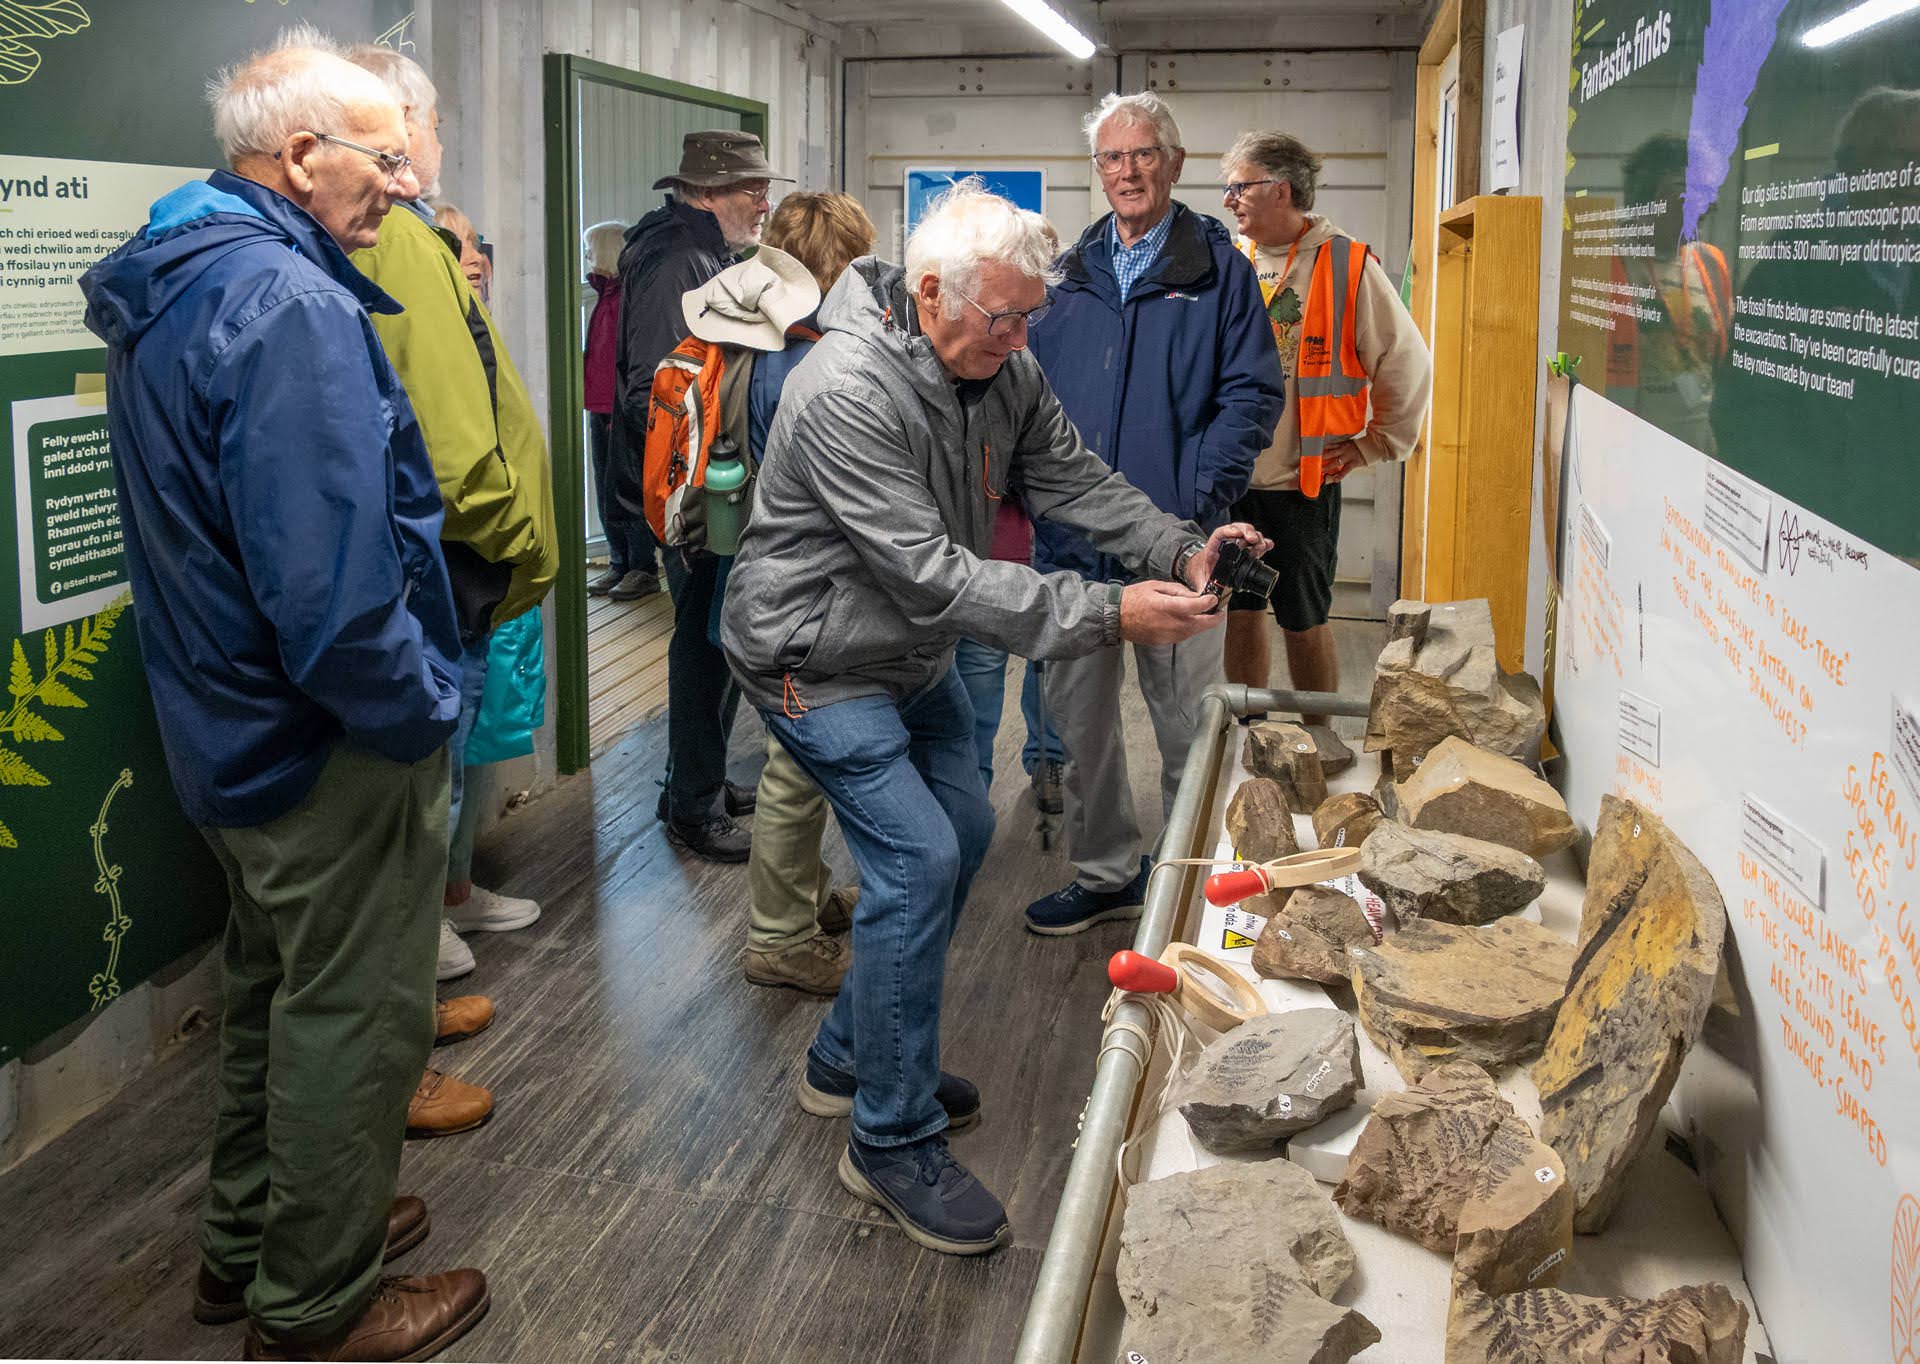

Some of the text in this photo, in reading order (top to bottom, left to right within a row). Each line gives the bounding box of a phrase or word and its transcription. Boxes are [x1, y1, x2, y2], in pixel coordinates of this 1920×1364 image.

[1581, 31, 1632, 104] Fantastic
[1634, 10, 1671, 71] finds
[55, 176, 88, 199] ati
[1742, 186, 1754, 205] Our
[1754, 185, 1765, 207] dig
[1766, 183, 1779, 202] site
[1780, 181, 1787, 201] is
[1787, 176, 1826, 201] brimming
[1827, 172, 1849, 195] with
[1849, 169, 1898, 192] evidence
[1899, 161, 1914, 187] of
[1740, 214, 1758, 232] From
[1758, 213, 1794, 230] enormous
[1795, 209, 1825, 229] insects
[1825, 208, 1835, 228] to
[1836, 201, 1899, 231] microscopic
[16, 227, 34, 239] chi
[37, 228, 72, 239] erioed
[74, 229, 99, 240] wedi
[4, 243, 31, 255] wedi
[34, 243, 73, 255] chwilio
[75, 245, 92, 254] am
[1739, 244, 1756, 259] more
[1756, 241, 1777, 259] about
[1777, 240, 1792, 260] this
[1792, 241, 1809, 260] 300
[1810, 240, 1838, 261] million
[1840, 244, 1862, 266] year
[1863, 239, 1881, 262] old
[7, 259, 50, 270] ffosilau
[53, 261, 66, 272] yn
[6, 275, 46, 288] cynnig
[48, 275, 73, 285] arni!
[1736, 295, 1919, 340] The fossil finds below are some of the latest
[1734, 323, 1745, 340] the
[1745, 328, 1788, 351] excavations.
[1789, 332, 1821, 360] They've
[1821, 338, 1845, 363] been
[1846, 346, 1893, 379] carefully
[1732, 349, 1856, 400] the key notes made by our team!
[42, 428, 105, 448] Felly ewch i
[43, 449, 74, 466] galed
[76, 445, 98, 458] a'ch
[44, 460, 109, 479] inni ddod yn
[46, 487, 111, 510] Rydym wrth
[46, 507, 80, 527] gweld
[47, 518, 105, 540] Rhannwch
[48, 540, 81, 557] gorau
[83, 534, 100, 547] efo
[102, 530, 113, 543] ni
[1758, 639, 1796, 697] PATTERN
[1799, 683, 1815, 713] ON
[1869, 751, 1917, 871] FERNS
[1842, 764, 1890, 890] SPORES
[1365, 896, 1382, 923] HEAVY
[1761, 870, 1780, 909] THE
[1783, 890, 1815, 940] LOWER
[1819, 919, 1867, 996] LAYERS
[1744, 898, 1756, 928] OF
[1759, 911, 1778, 949] THE
[1816, 967, 1834, 1010] ITS
[1840, 987, 1886, 1065] LEAVES
[1770, 962, 1873, 1092] ARE ROUND AND
